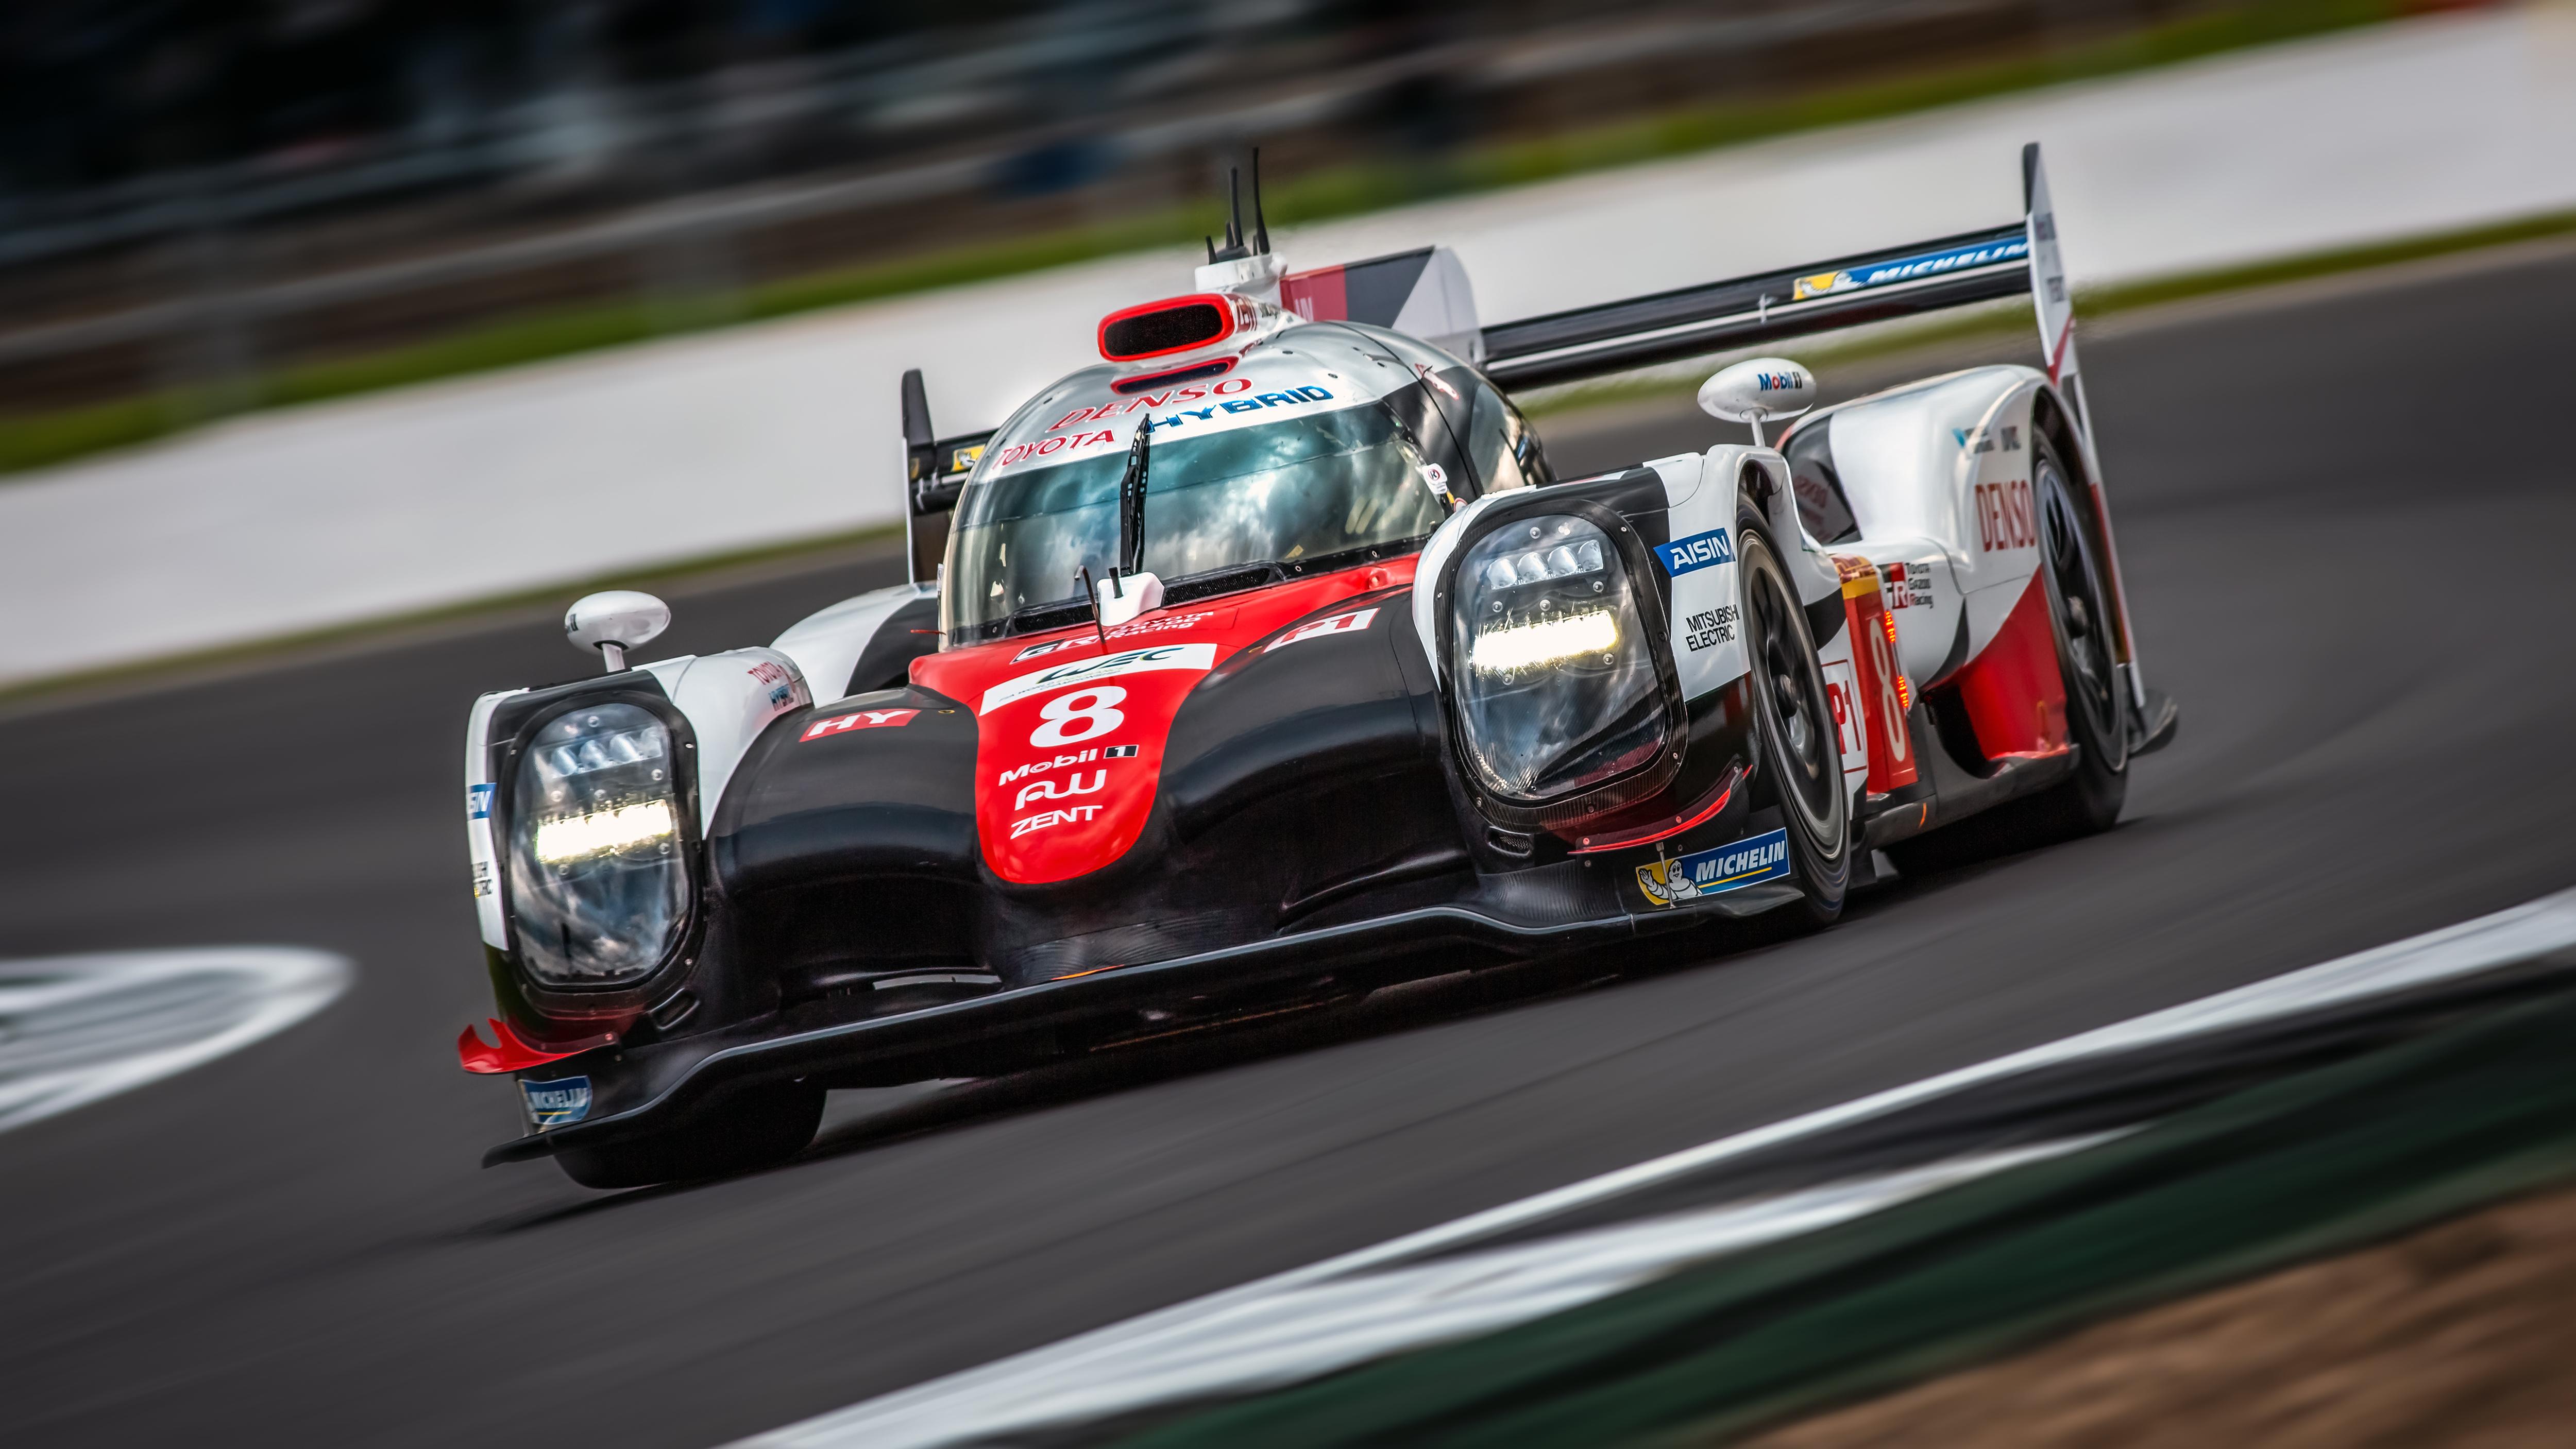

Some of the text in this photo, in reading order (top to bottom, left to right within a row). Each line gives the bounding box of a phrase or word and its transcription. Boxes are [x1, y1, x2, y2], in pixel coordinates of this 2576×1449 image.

[1866, 242, 2028, 283] MICHELIN
[1757, 371, 1793, 391] Mobil
[1046, 378, 1254, 433] DENSO
[1147, 385, 1334, 434] HYBRID
[991, 429, 1116, 470] TOYOTA
[1975, 479, 2036, 553] DENSO
[1670, 535, 1730, 570] AISIN
[1104, 622, 1195, 640] Racing
[1280, 614, 1358, 644] P1
[1685, 604, 1740, 633] MITSUBISHI
[1012, 634, 1104, 663] GR
[1685, 624, 1735, 652] ELECTRIC
[1036, 646, 1185, 684] WEC
[1826, 618, 1906, 762] P1 8
[807, 710, 912, 737] HY
[1029, 685, 1127, 747] 8
[998, 748, 1098, 787] Mobil
[1010, 805, 1104, 840] ZENT
[1696, 840, 1785, 882] MICHELIN
